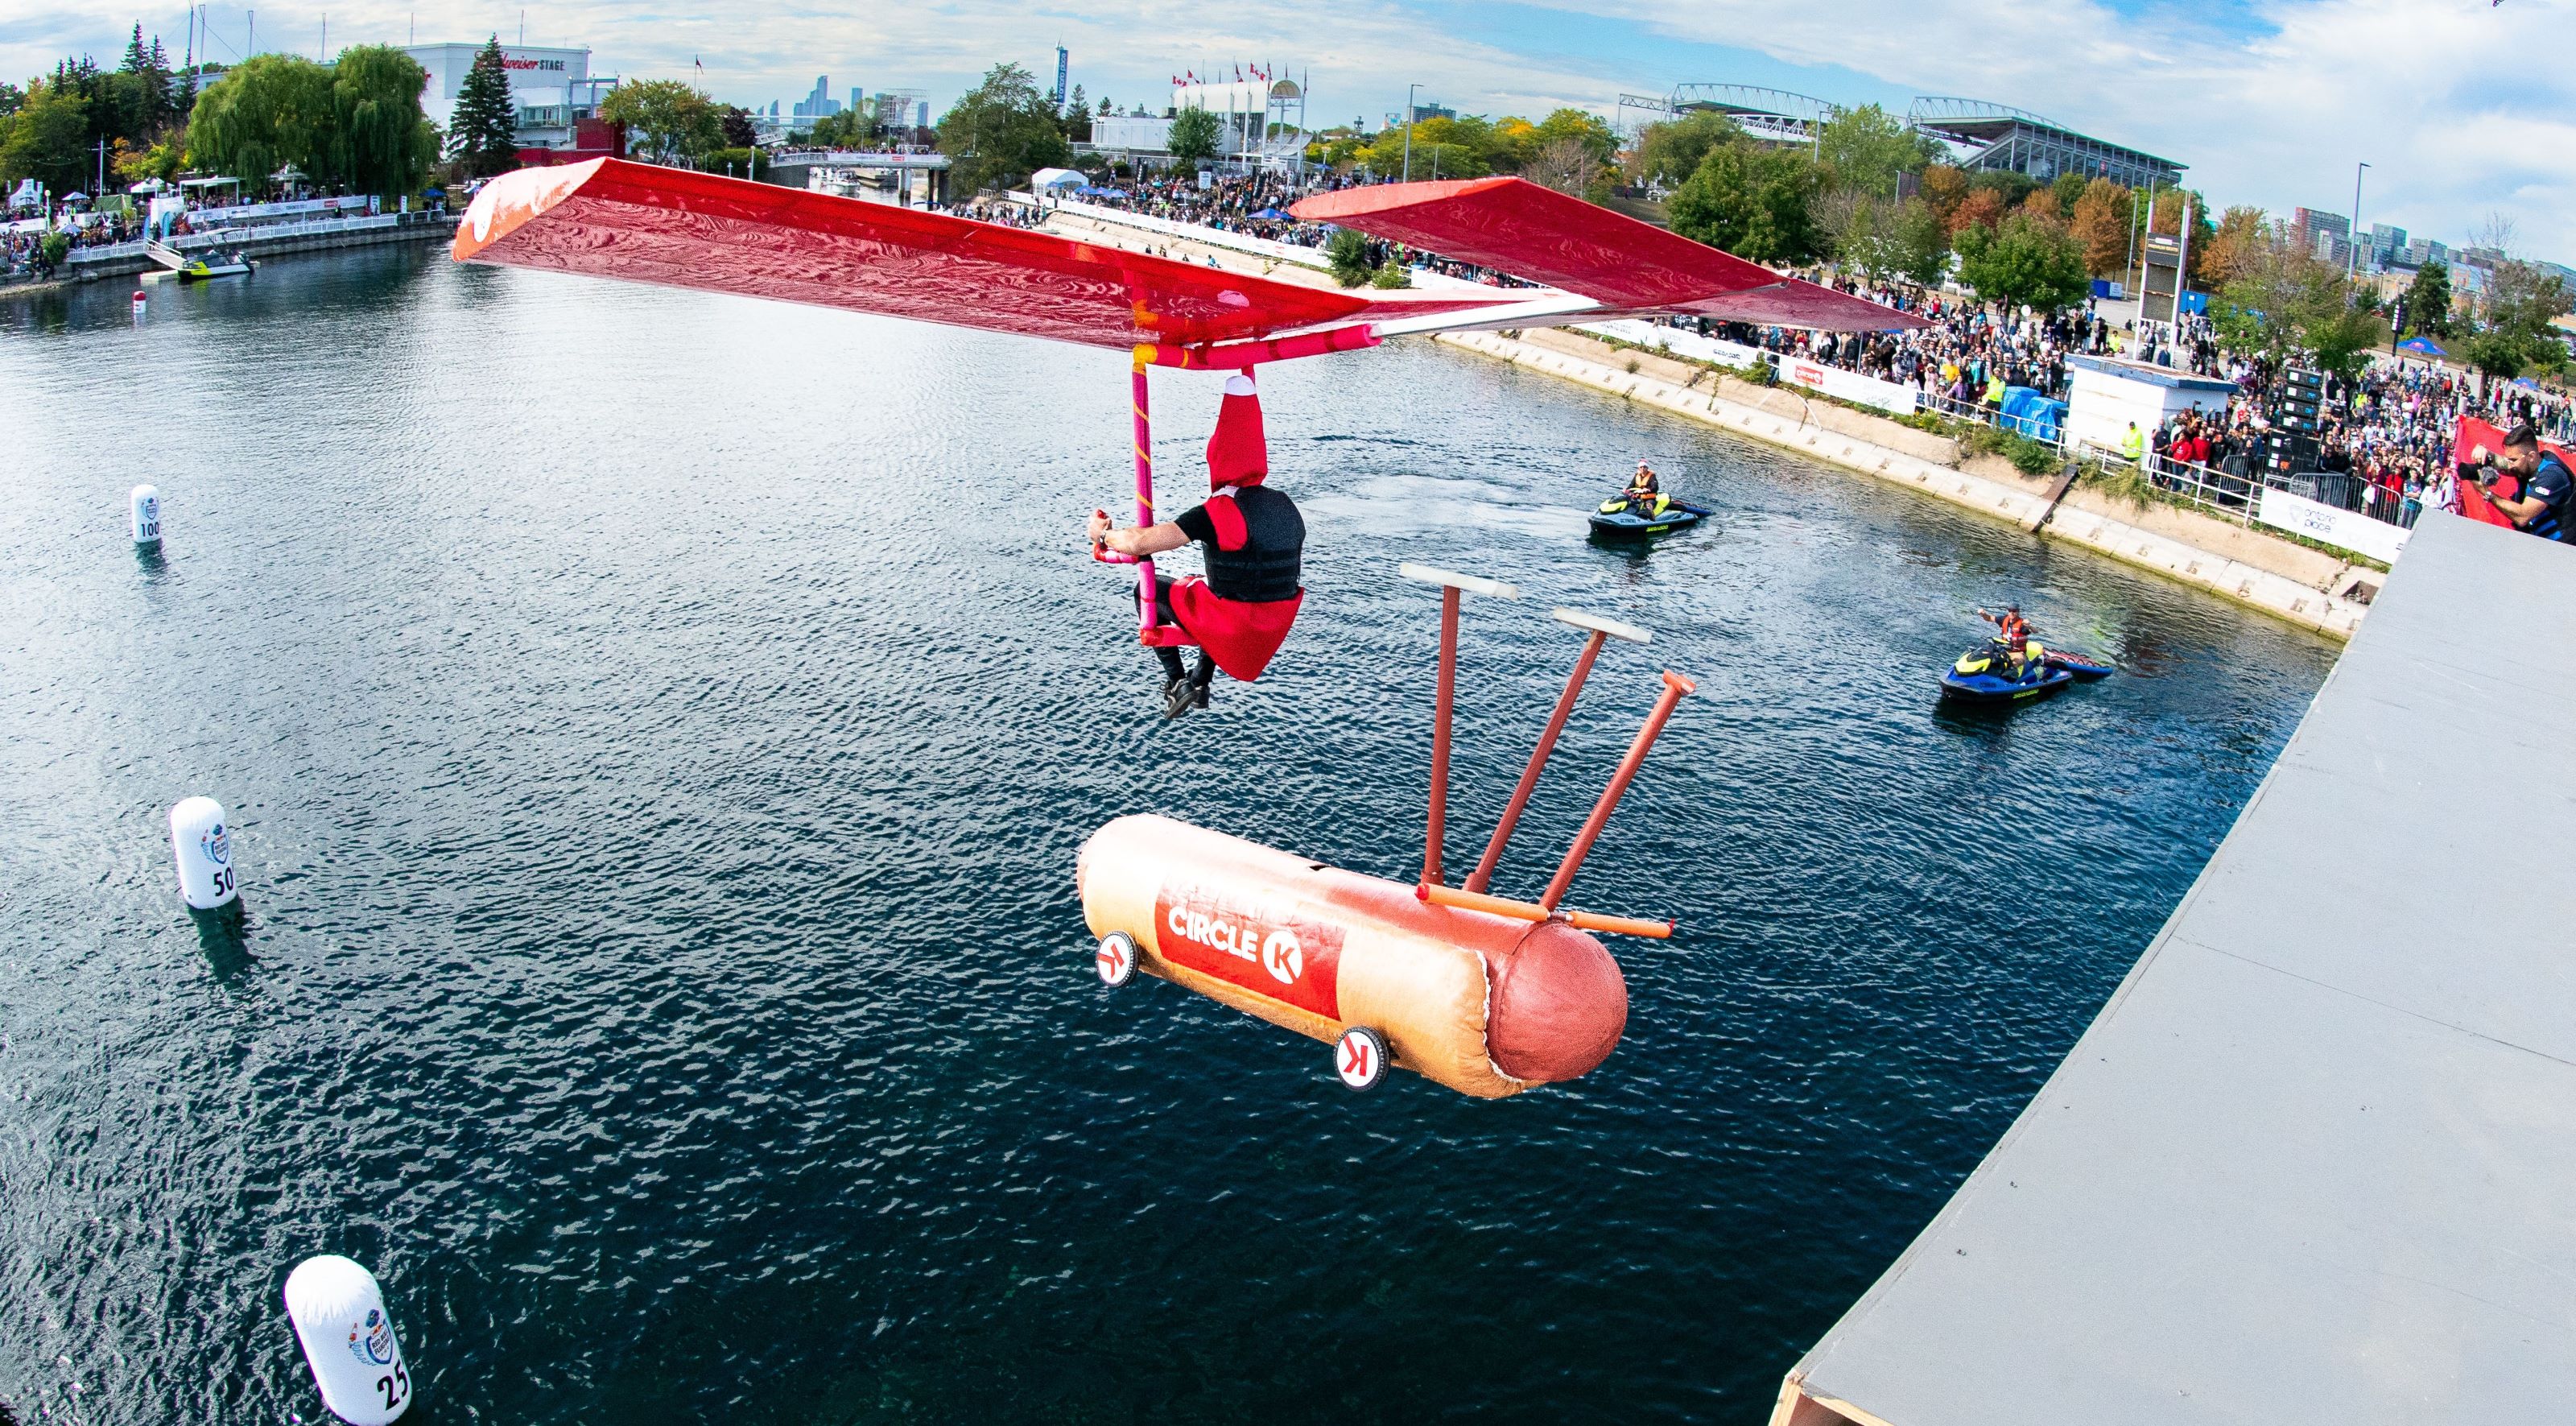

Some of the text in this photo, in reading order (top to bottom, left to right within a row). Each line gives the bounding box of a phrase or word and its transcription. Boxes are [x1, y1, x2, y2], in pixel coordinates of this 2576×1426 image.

[540, 60, 566, 71] STAGE
[2305, 509, 2336, 524] ontario
[141, 522, 159, 537] 100
[2305, 519, 2331, 533] place
[213, 866, 233, 897] 50
[1168, 907, 1298, 982] CIRCLE K
[377, 1358, 409, 1411] 25
